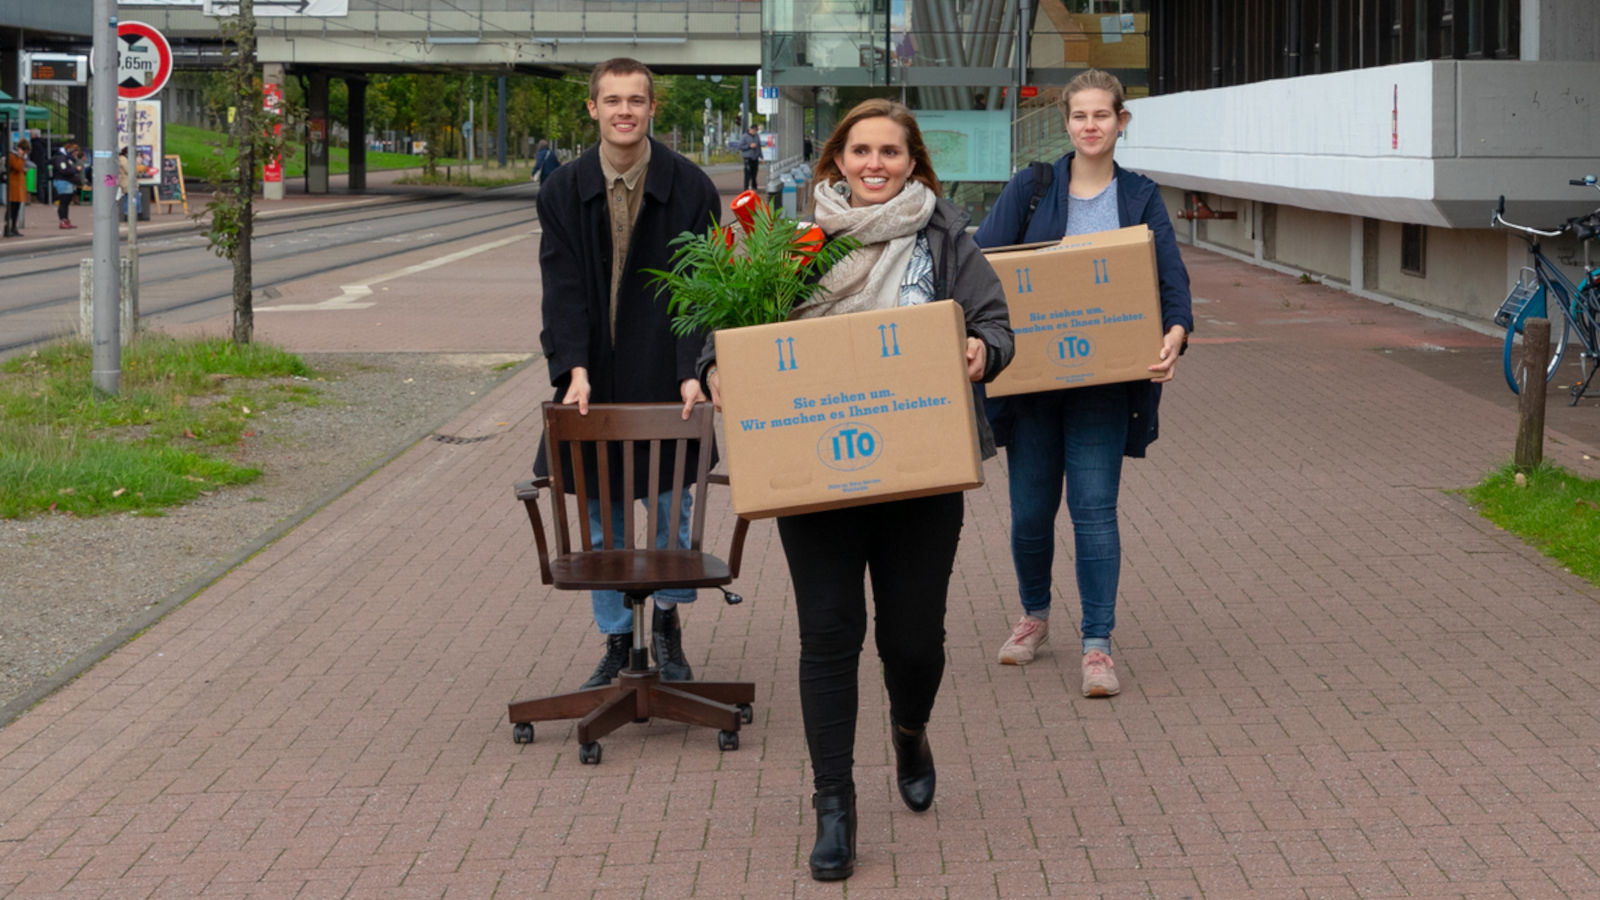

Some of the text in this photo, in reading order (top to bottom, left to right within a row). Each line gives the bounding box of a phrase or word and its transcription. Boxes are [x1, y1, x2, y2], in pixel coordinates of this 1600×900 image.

[1029, 306, 1105, 322] Sie ziehen um.
[1056, 322, 1069, 330] es
[1070, 318, 1101, 329] Ihnen
[1103, 313, 1147, 324] leichter.
[793, 388, 896, 410] Sie ziehen um.
[740, 395, 951, 432] Wir machen es Ihnen leichter.
